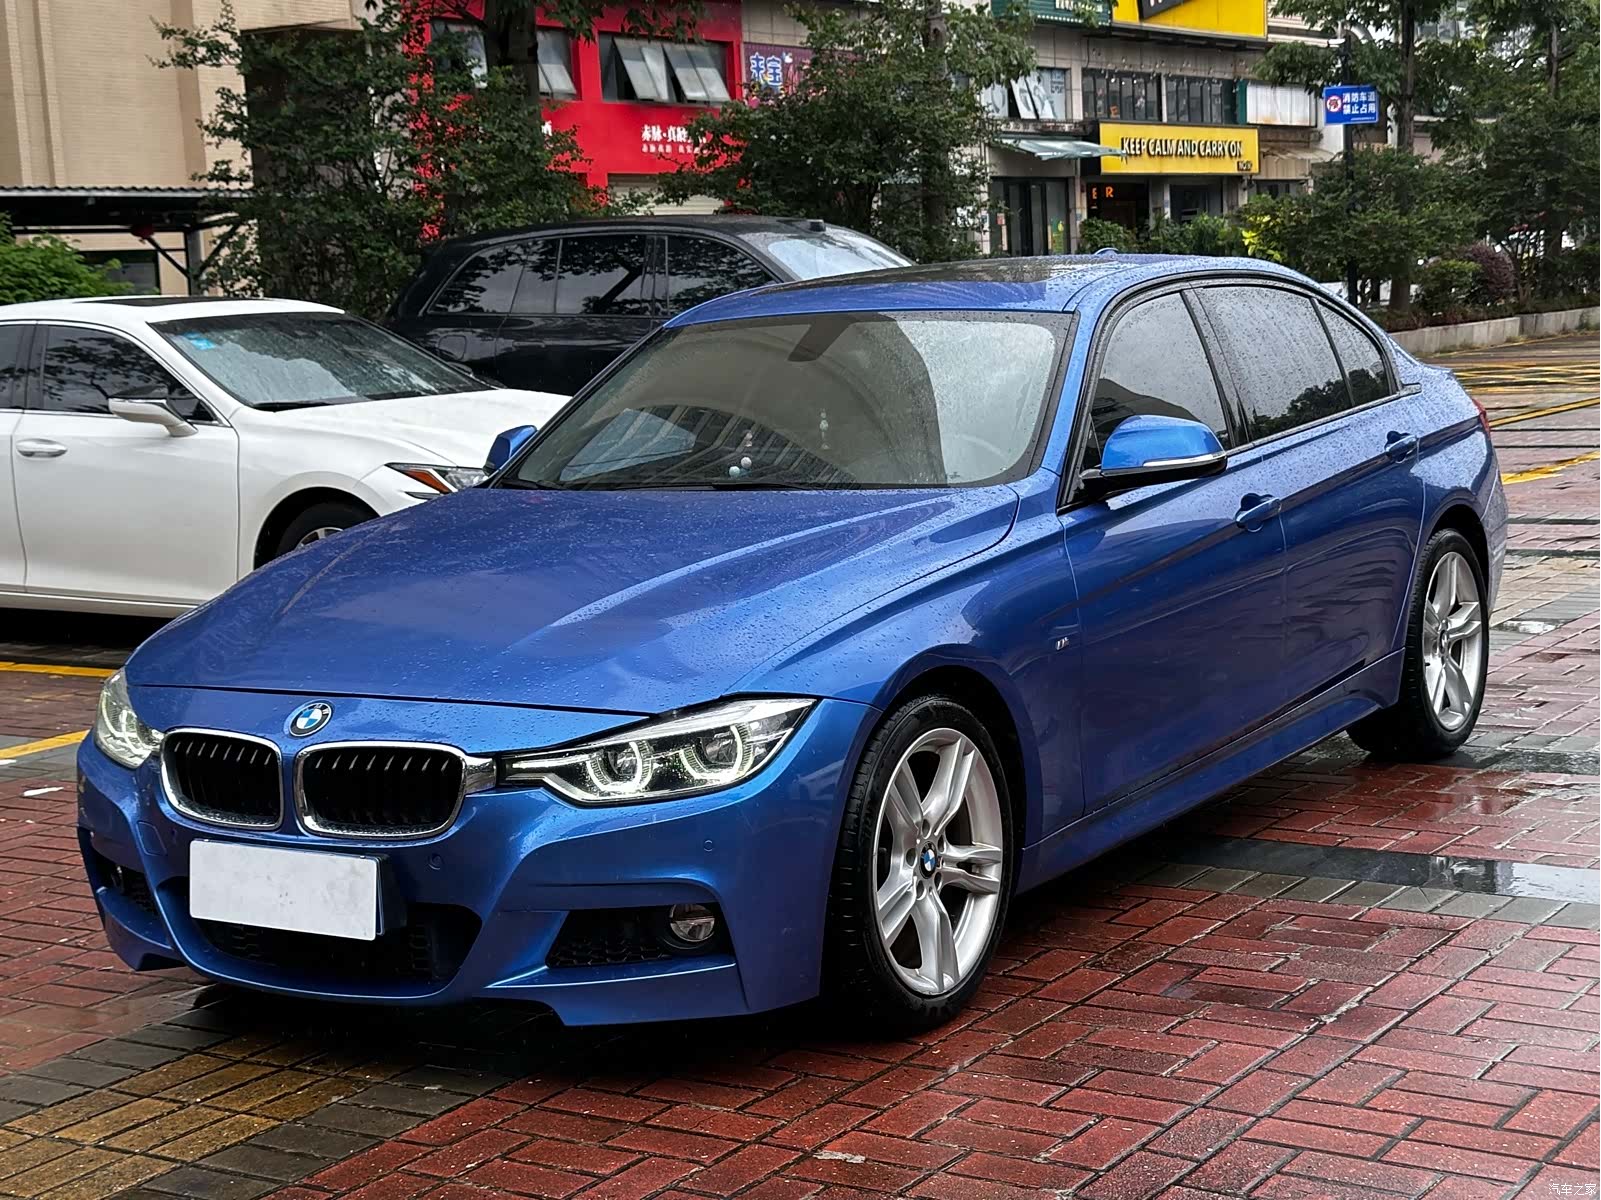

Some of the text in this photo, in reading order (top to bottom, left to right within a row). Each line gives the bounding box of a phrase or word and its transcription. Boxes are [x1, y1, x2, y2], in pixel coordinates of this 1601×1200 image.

[750, 52, 782, 85] 来宝
[1342, 91, 1375, 103] 消防车道
[1342, 103, 1376, 115] 禁止占用
[1121, 137, 1242, 158] KEEP CALM AND CARRY ON
